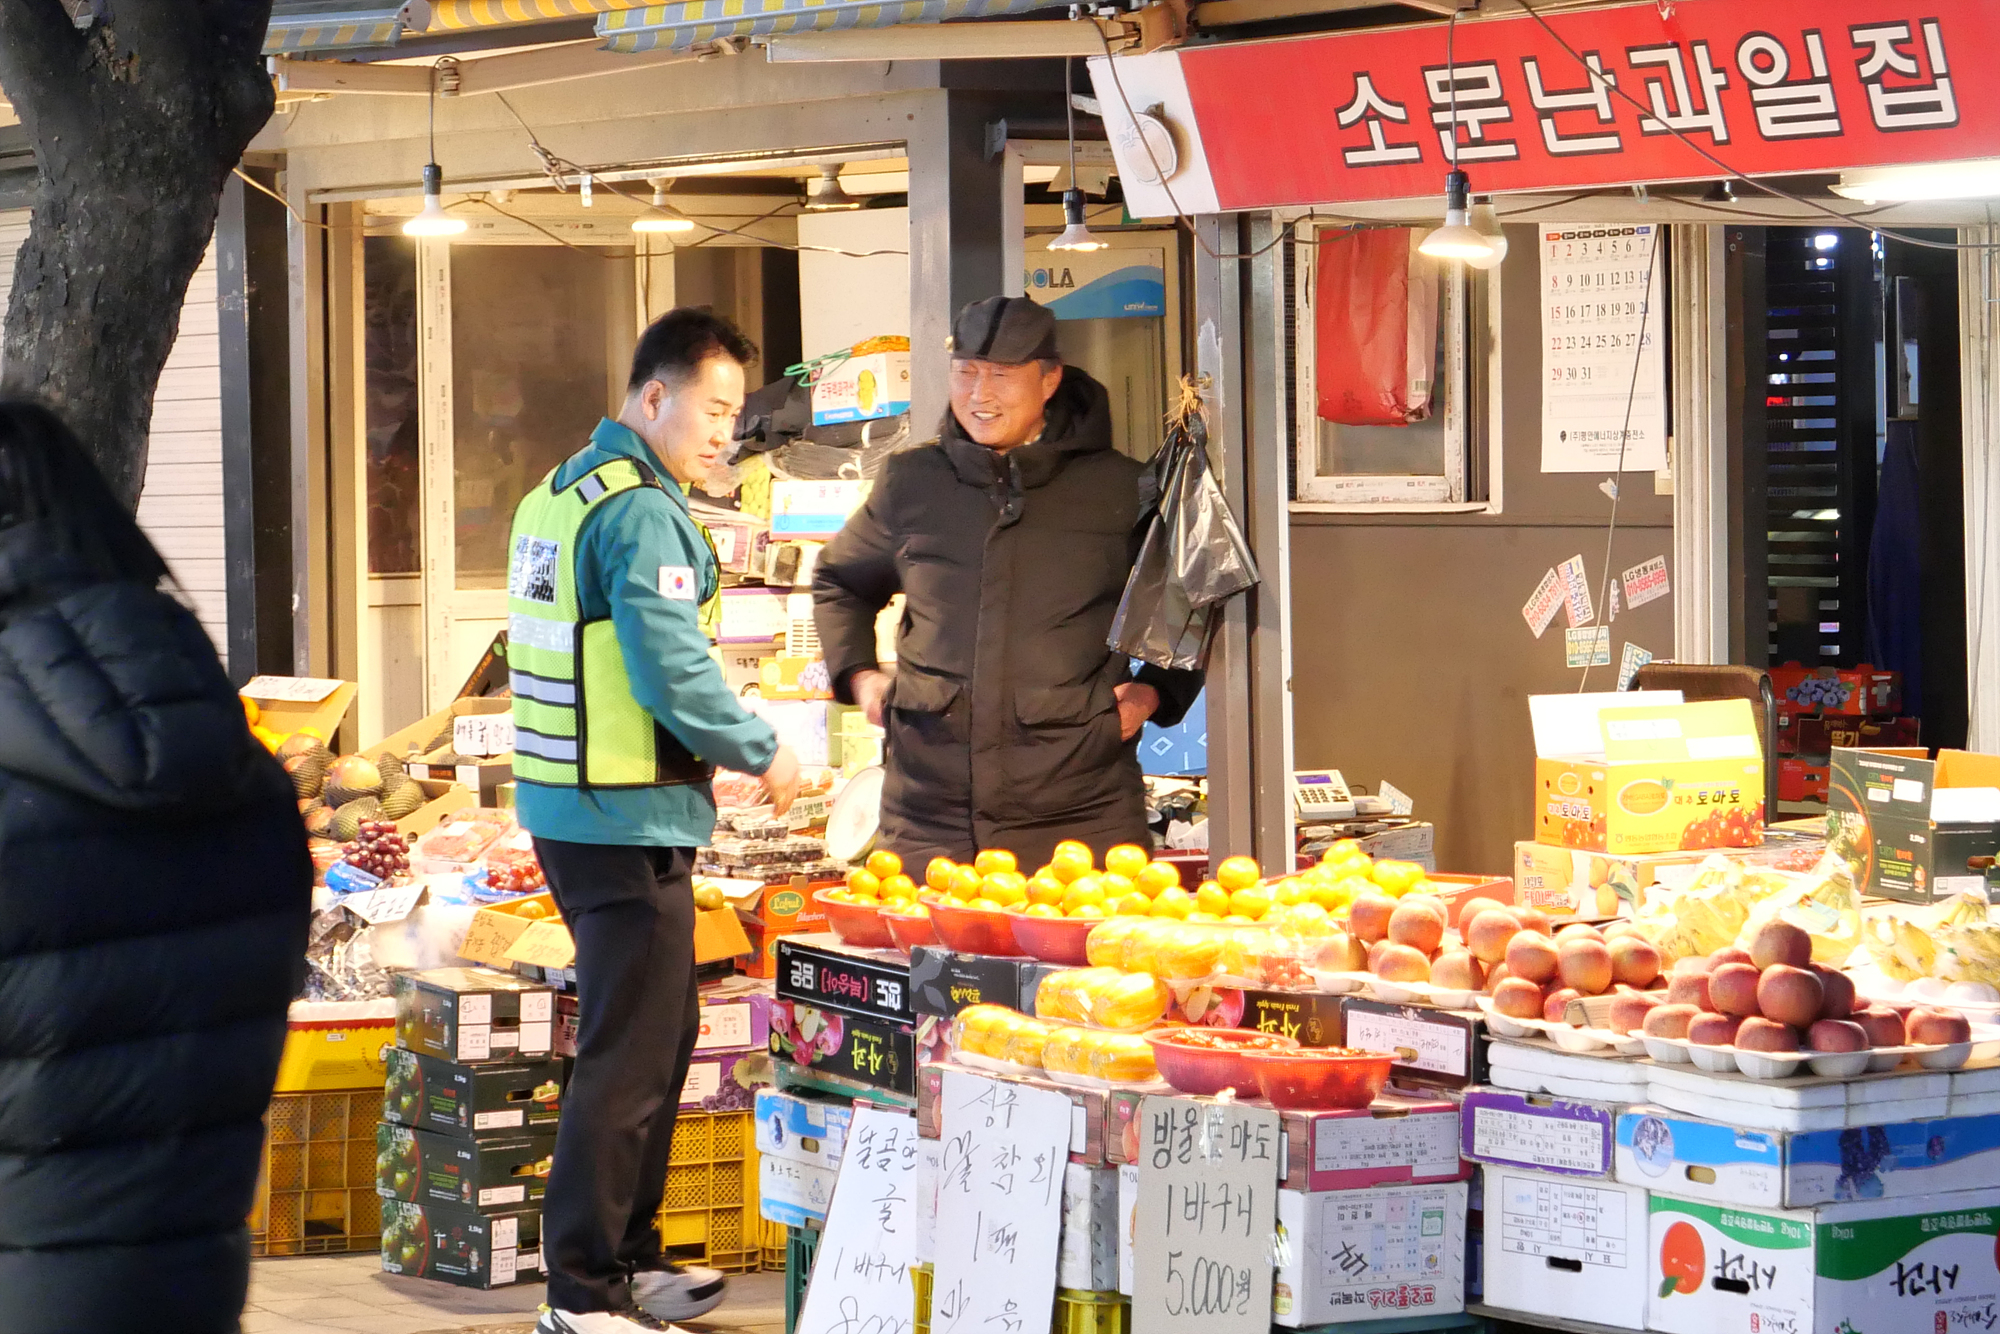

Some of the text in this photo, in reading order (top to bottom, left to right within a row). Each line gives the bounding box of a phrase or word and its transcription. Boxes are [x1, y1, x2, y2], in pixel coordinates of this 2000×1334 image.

[1337, 17, 1960, 168] 소문난과일집
[1551, 238, 1647, 258] 1 2 3 4 5 6 7
[1552, 275, 1558, 288] 8
[1566, 274, 1573, 287] 9
[1580, 273, 1590, 287] 10
[1596, 273, 1605, 286] 11
[1610, 272, 1620, 285] 12
[1624, 271, 1634, 284] 13
[1551, 306, 1561, 319] 15
[1565, 305, 1576, 319] 16
[1580, 304, 1591, 318] 17
[1596, 303, 1606, 317] 18
[1611, 302, 1621, 316] 19
[1625, 302, 1635, 315] 20
[1551, 337, 1562, 350] 22
[1566, 336, 1576, 349] 23
[1580, 336, 1591, 349] 24
[1596, 335, 1607, 348] 25
[1611, 334, 1621, 347] 26
[1625, 333, 1636, 347] 27
[1552, 366, 1591, 381] 29 30 31
[1831, 731, 1859, 747] 딸기
[1674, 789, 1740, 806] 대추 토마토
[1561, 804, 1591, 821] 토마토
[1256, 1000, 1300, 1012] Fresh Fruits Apple
[851, 1038, 883, 1076] 사과
[856, 1125, 917, 1171] 달콤한
[1166, 1181, 1253, 1237] 1 바구니
[973, 1211, 981, 1262] 1
[1780, 1222, 1802, 1239] 10kg
[1831, 1225, 1855, 1239] 10kg
[834, 1247, 906, 1284] 1 바구니
[1714, 1249, 1777, 1292] 사과
[1890, 1261, 1959, 1297] 사과
[1330, 1284, 1435, 1309] 프로폴리스 작목반
